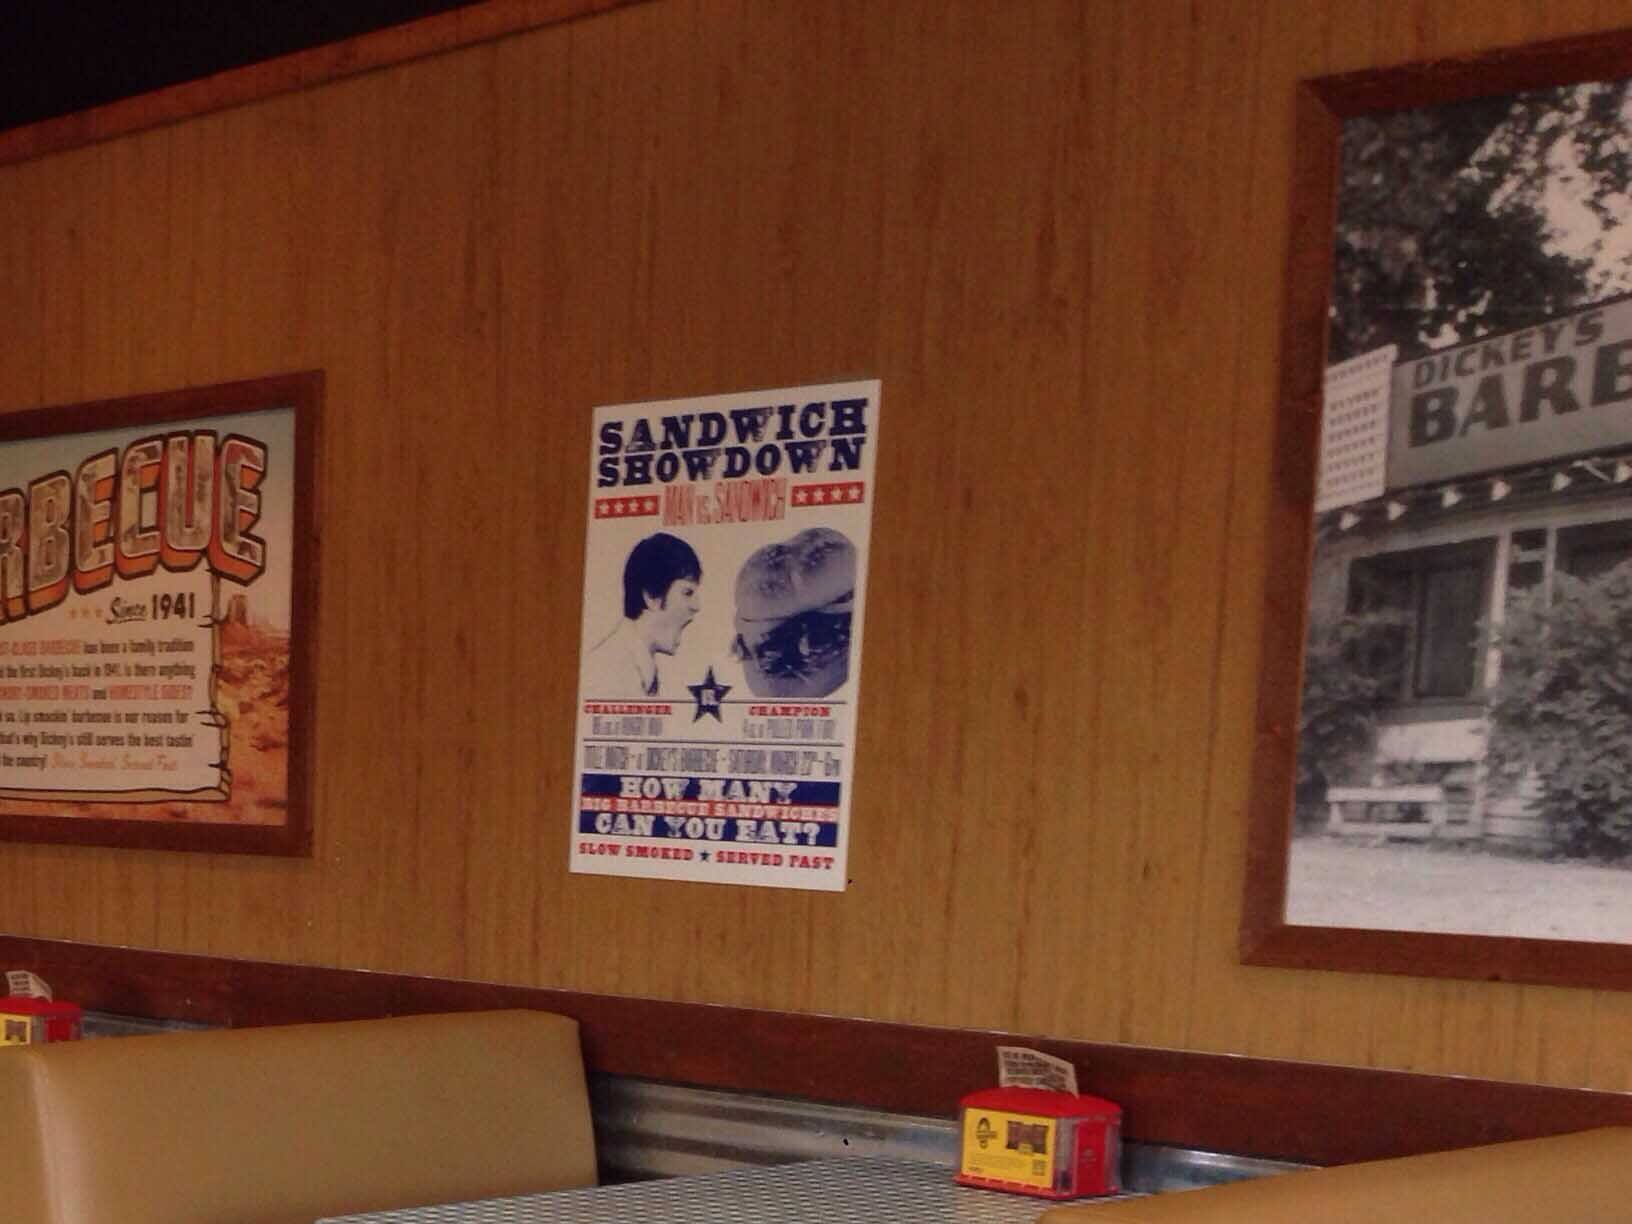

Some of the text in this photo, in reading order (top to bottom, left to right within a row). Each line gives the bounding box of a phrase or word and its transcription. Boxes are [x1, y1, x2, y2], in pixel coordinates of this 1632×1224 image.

[598, 398, 868, 456] SANDWICH
[597, 436, 866, 488] SHOWDOWN
[151, 592, 196, 620] 1941
[748, 704, 831, 718] CHAMPION
[619, 776, 798, 805] HOW MANY
[711, 802, 840, 824] SANDWICHES
[594, 812, 822, 845] CAN YOU EAT?
[578, 842, 836, 871] SLOW SMOKED SERVED FAST
